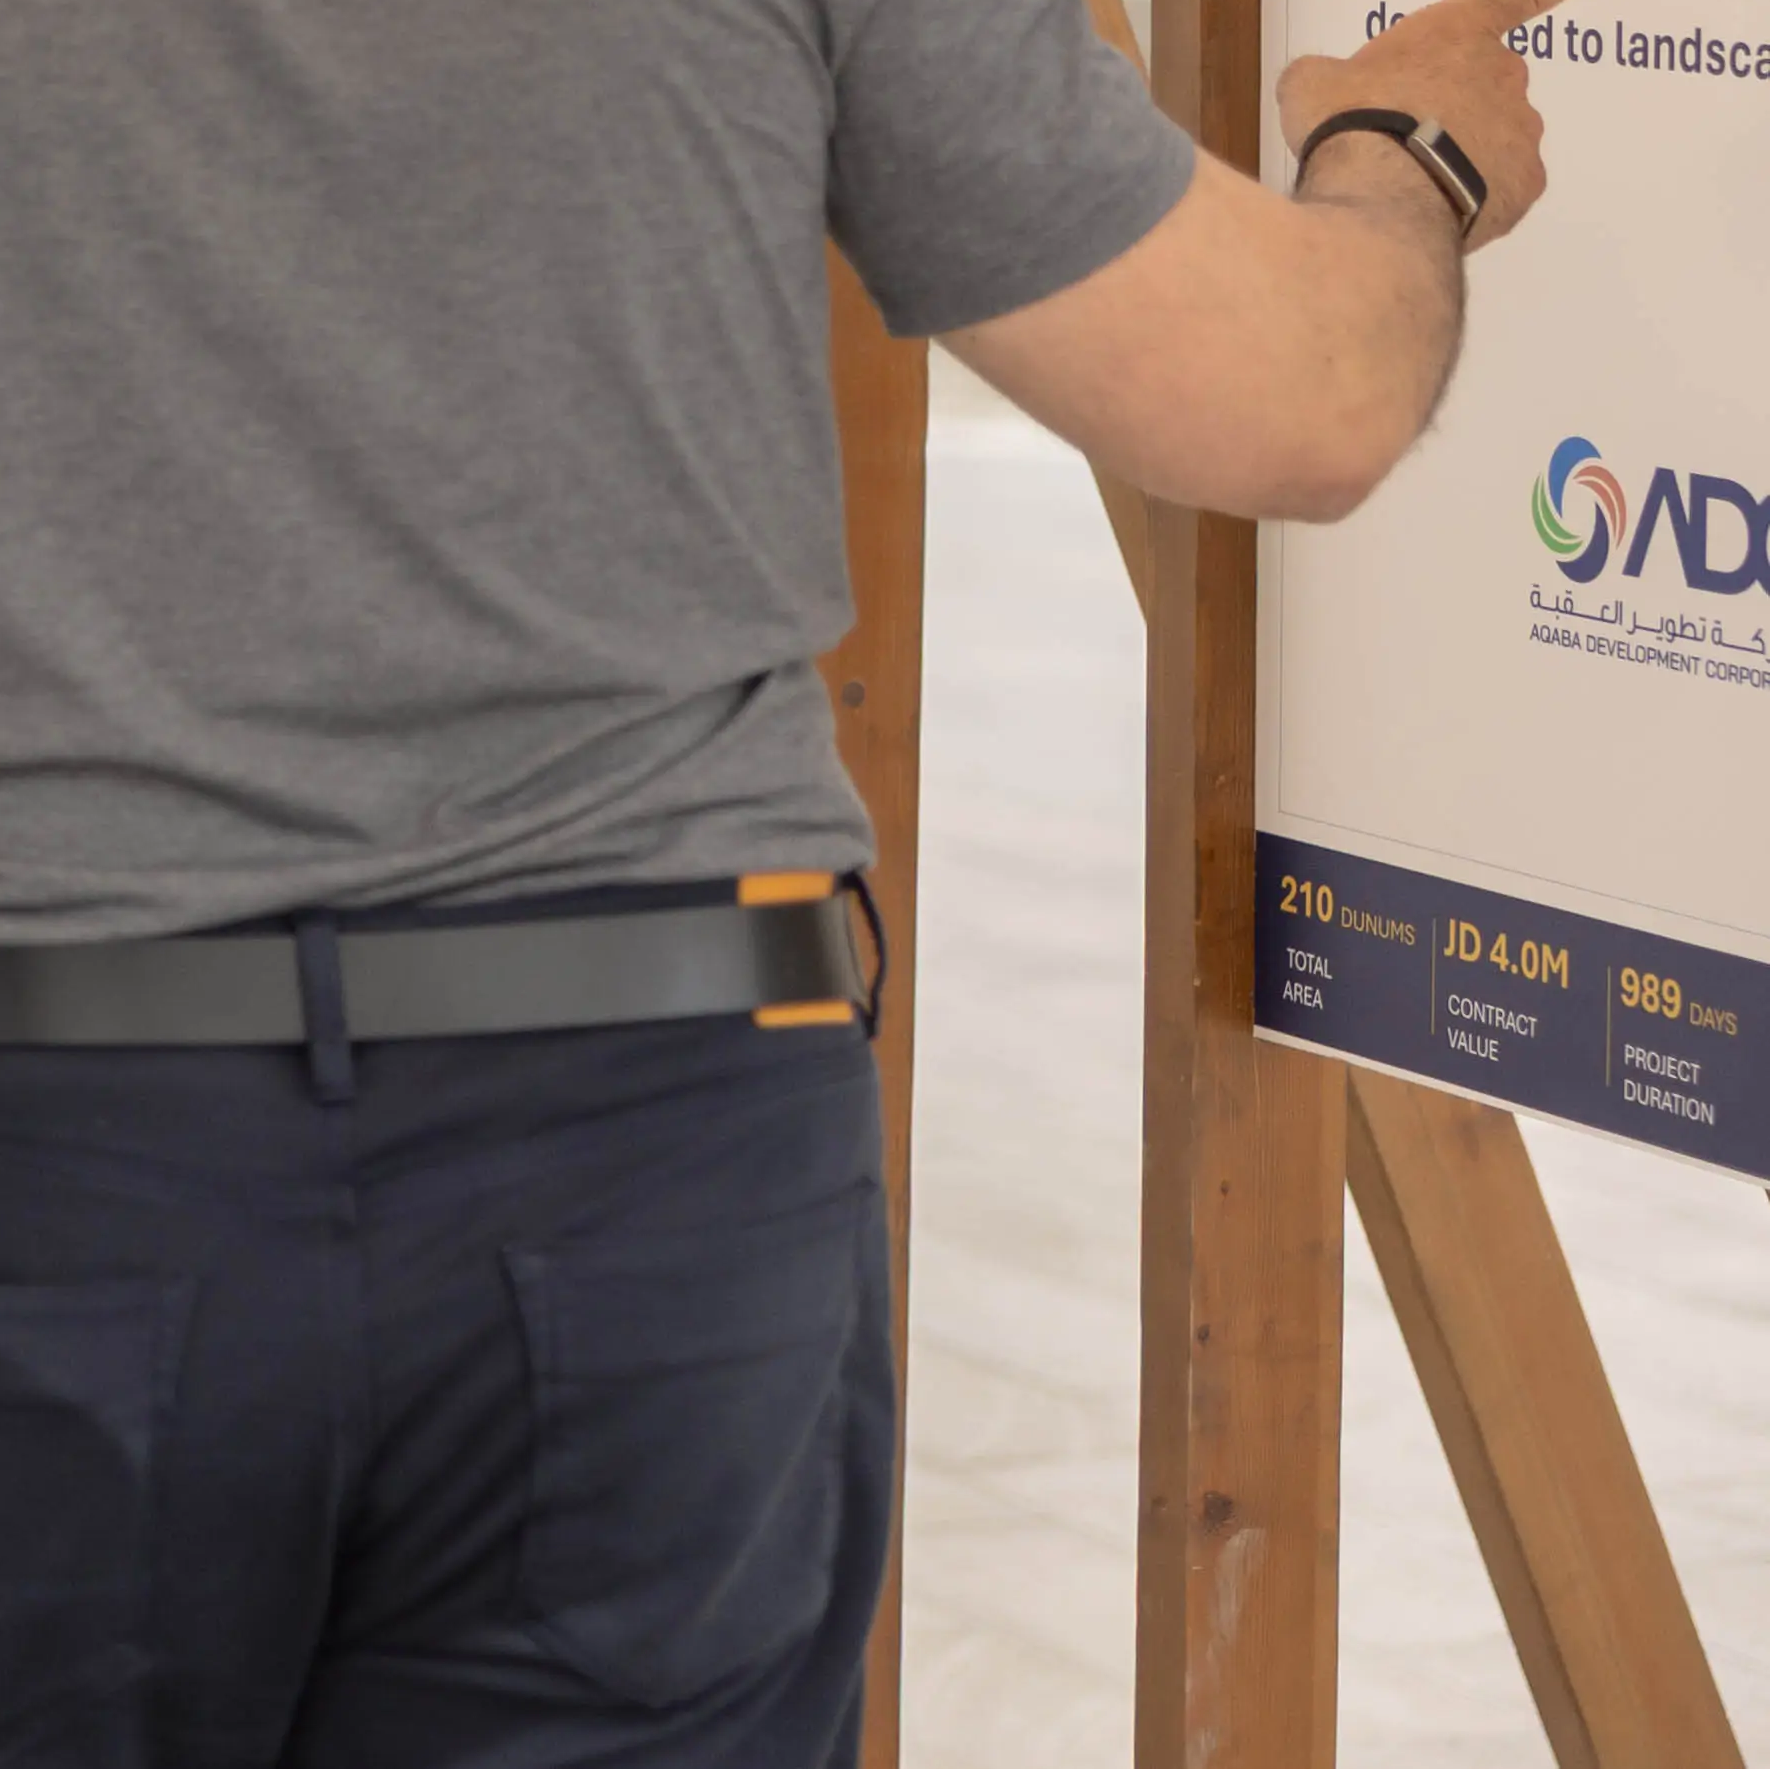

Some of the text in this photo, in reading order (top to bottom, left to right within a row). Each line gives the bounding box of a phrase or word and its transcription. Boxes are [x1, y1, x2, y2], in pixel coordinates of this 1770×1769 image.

[1564, 20, 1603, 64] to
[1622, 466, 1770, 598] AD
[1530, 583, 1623, 625] العقبة
[1530, 623, 1582, 651] AQABA
[1587, 634, 1700, 676] DEVELOPMENT
[1626, 612, 1706, 643] تطوير
[1280, 875, 1416, 946] 210 DUNUMS
[1286, 946, 1332, 980] TOTAL
[1443, 918, 1570, 989] JD 4.0M
[1282, 979, 1324, 1010] AREA
[1447, 994, 1538, 1038] CONTRACT
[1620, 967, 1738, 1036] 989 DAYS
[1447, 1026, 1499, 1062] VALUE
[1624, 1043, 1701, 1085] PROJECT
[1623, 1078, 1715, 1126] DURATION
